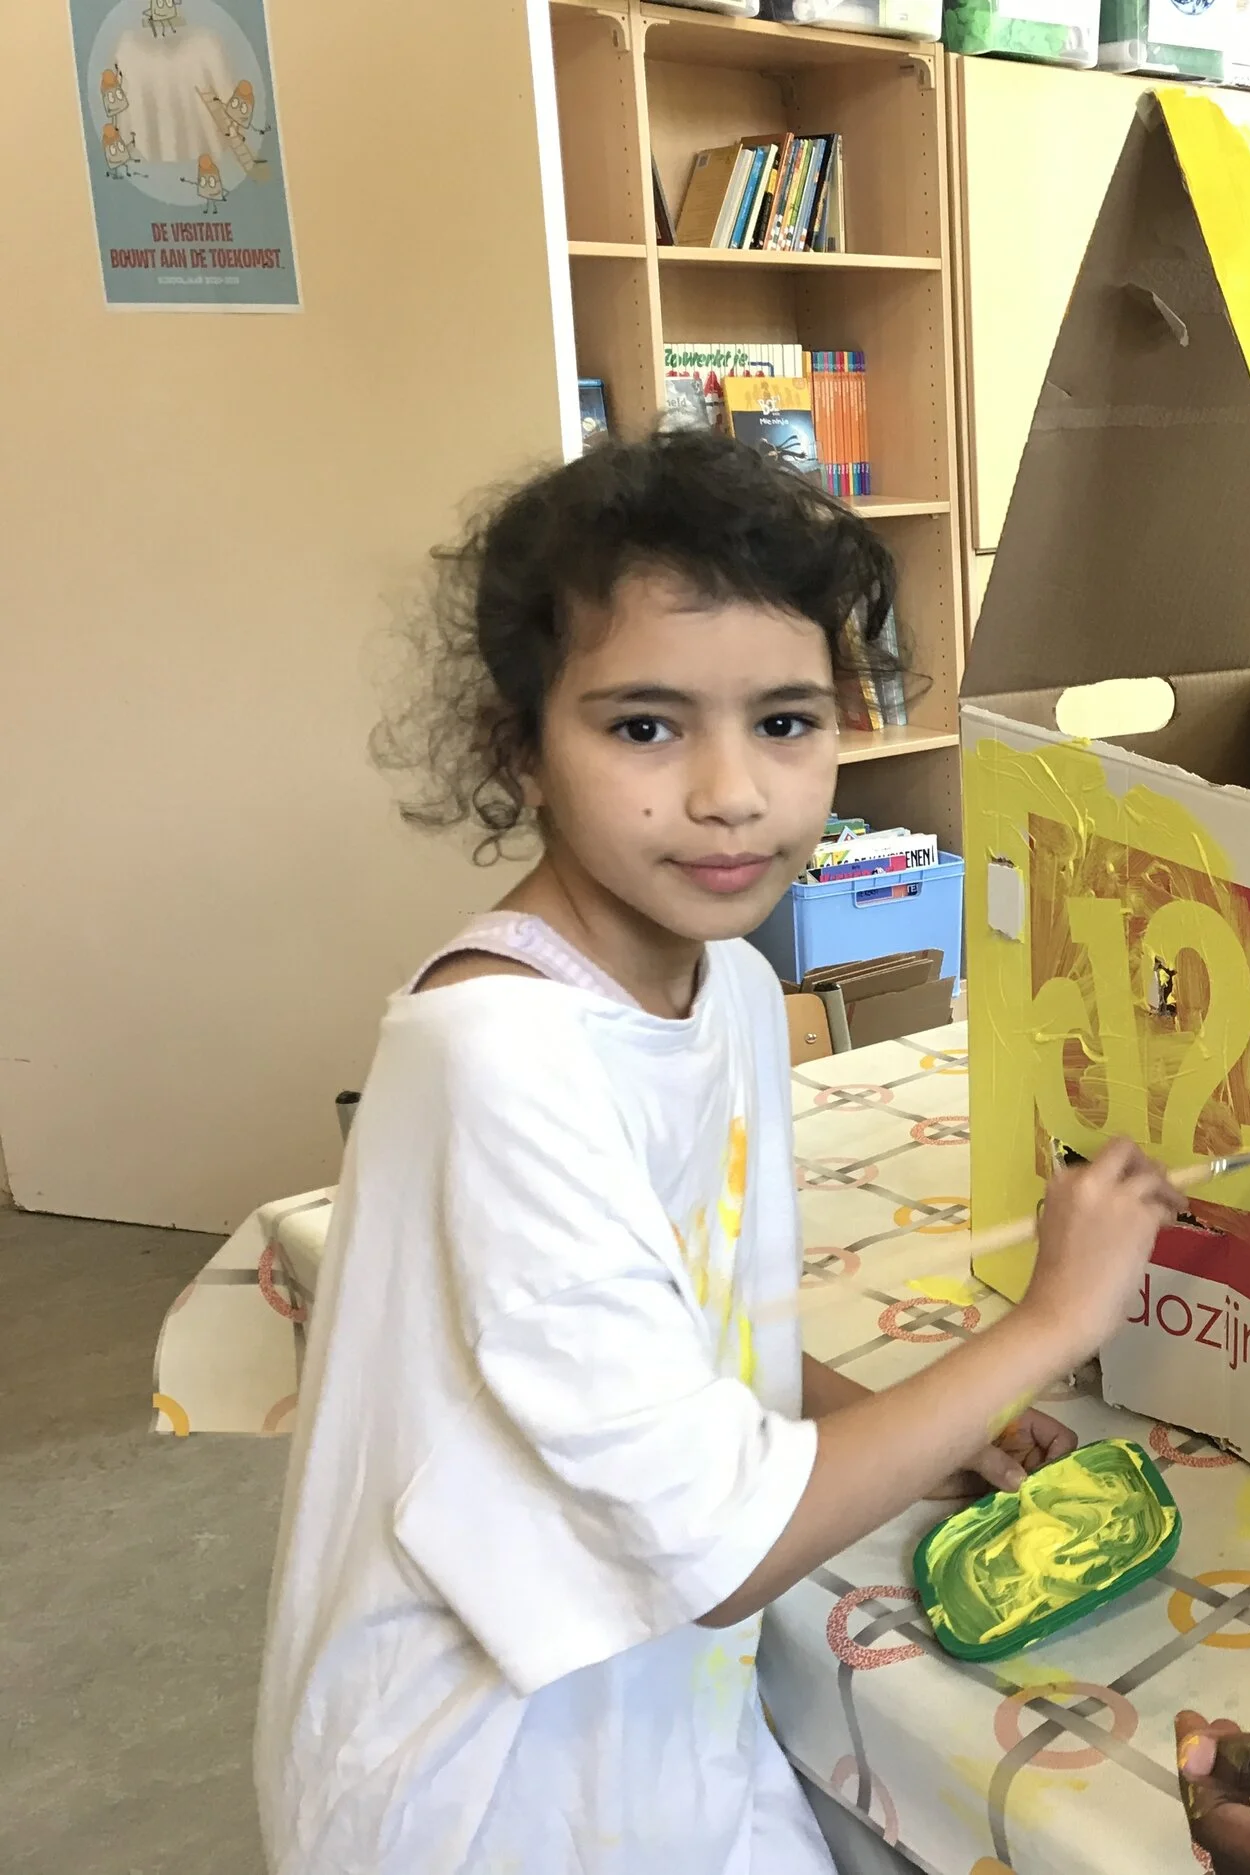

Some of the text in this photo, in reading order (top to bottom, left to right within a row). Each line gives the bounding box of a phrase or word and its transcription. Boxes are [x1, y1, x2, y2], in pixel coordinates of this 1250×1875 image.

[151, 222, 233, 242] DE VISITATIE
[110, 248, 281, 269] BOUWT AAN DE TOEKOMST
